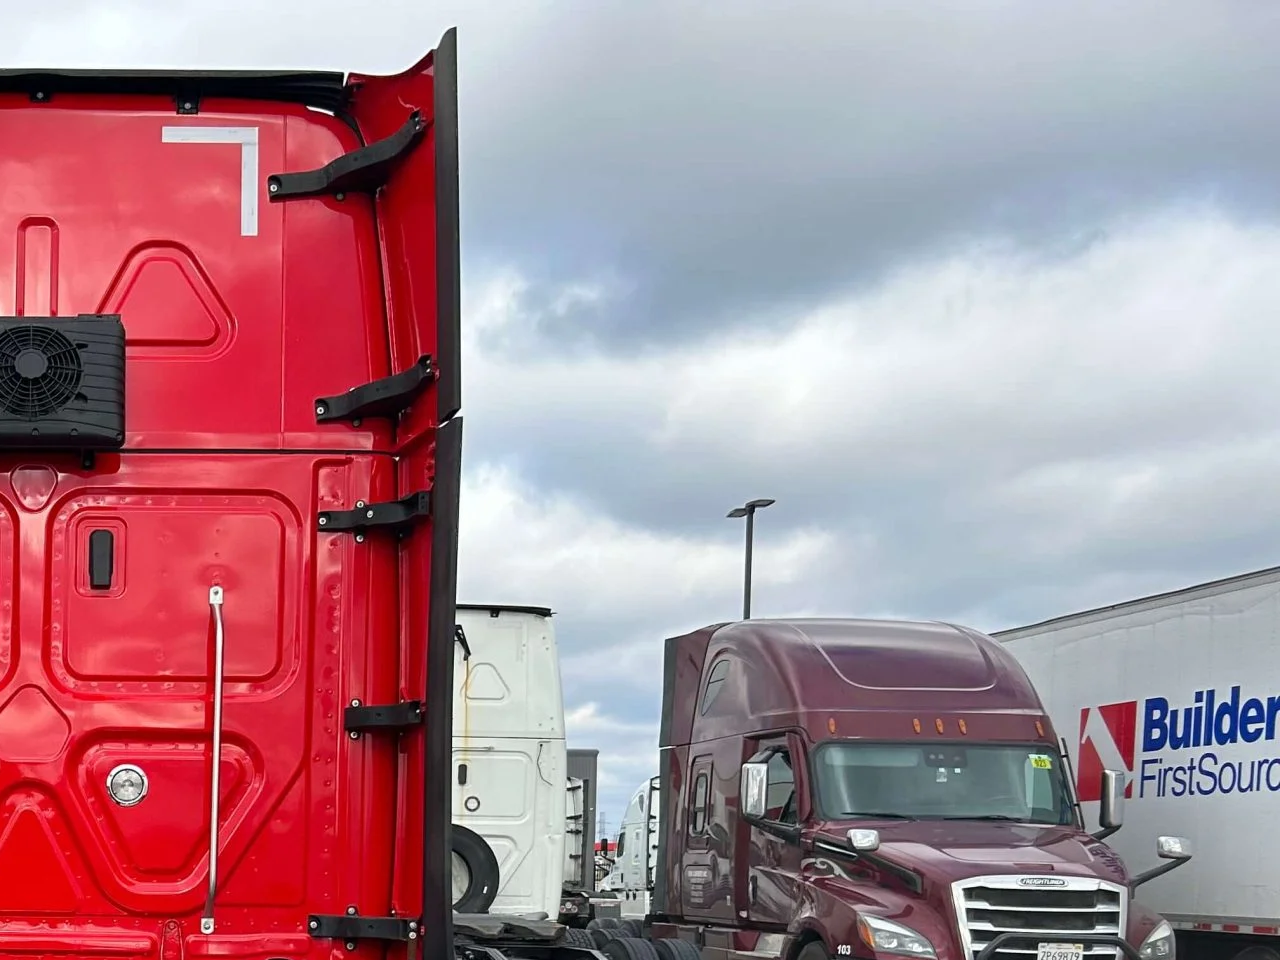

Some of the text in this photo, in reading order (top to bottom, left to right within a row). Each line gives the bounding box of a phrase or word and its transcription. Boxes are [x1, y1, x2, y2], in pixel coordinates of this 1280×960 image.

[1142, 686, 1280, 752] Builder
[1139, 752, 1280, 798] FirstSourc
[837, 944, 851, 955] 103
